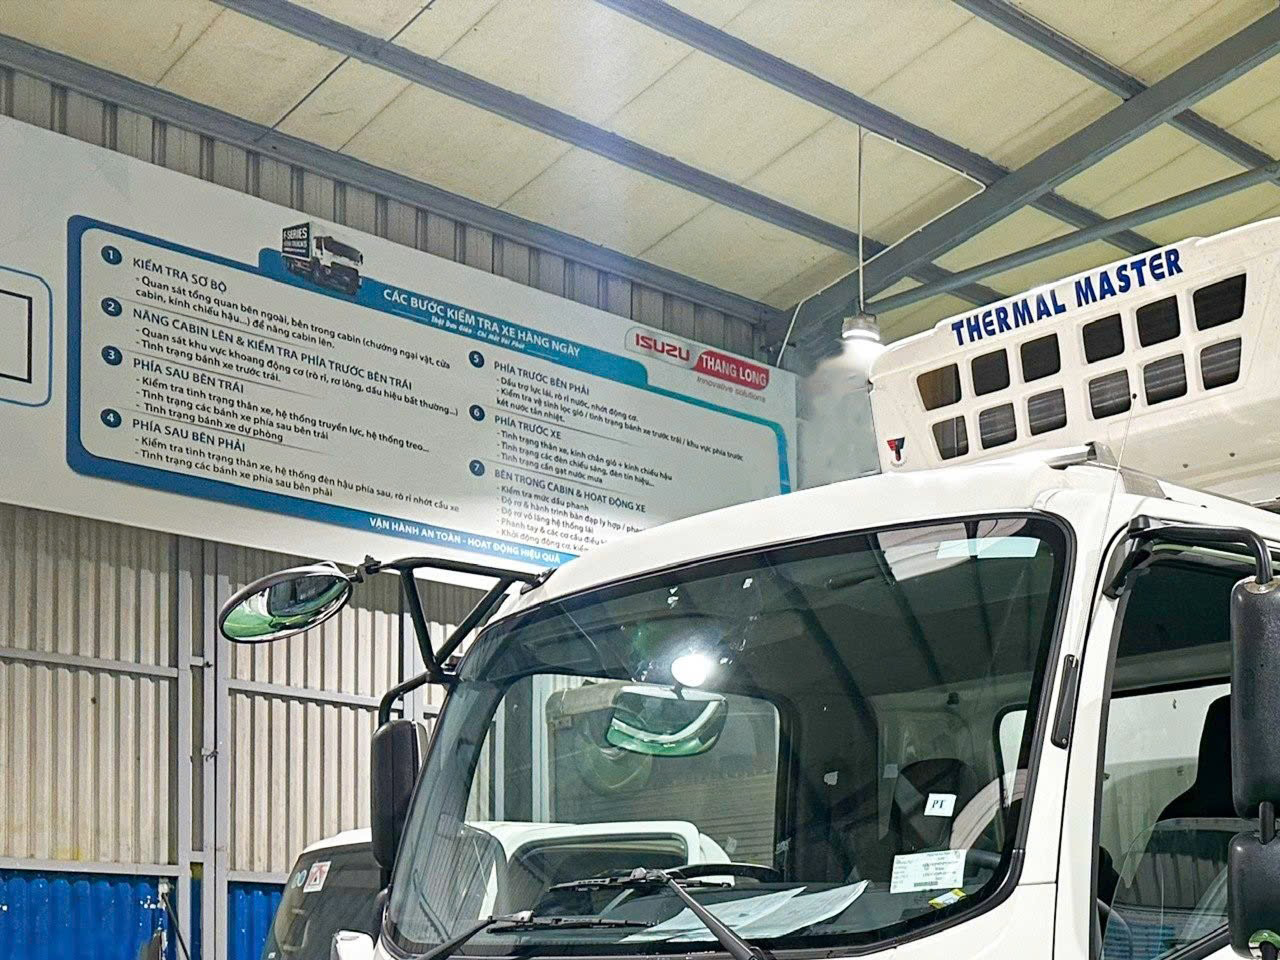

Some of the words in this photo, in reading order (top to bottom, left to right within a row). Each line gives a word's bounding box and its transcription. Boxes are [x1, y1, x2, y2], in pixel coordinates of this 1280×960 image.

[108, 249, 113, 259] 1
[132, 257, 163, 274] KIỂM
[164, 265, 189, 282] TRA
[191, 273, 208, 287] SƠ
[210, 278, 227, 294] BỘ
[951, 289, 1066, 346] THERMAL
[1074, 248, 1183, 308] MASTER
[383, 288, 408, 305] CÁC
[410, 296, 445, 316] BƯỚC
[446, 307, 475, 326] KIỂM
[476, 316, 500, 333] TRA
[501, 324, 516, 338] XE
[517, 329, 549, 348] HÀNG
[551, 340, 580, 356] NGÀY
[107, 300, 115, 312] 2
[133, 307, 169, 327] NÂNG
[171, 318, 209, 337] CABIN
[211, 329, 233, 344] LÊN
[235, 335, 245, 347] &
[246, 338, 275, 354] KIỂM
[276, 345, 298, 360] TRA
[300, 352, 327, 369] PHÍA
[327, 359, 364, 379] TRƯỚC
[366, 370, 387, 384] BÊN
[388, 376, 412, 391] TRÁI
[635, 333, 690, 362] ISUZU
[701, 354, 737, 377] THANG
[739, 368, 767, 386] LONG
[107, 349, 115, 360] 3
[133, 357, 163, 374] PHÍA
[165, 365, 189, 380] SAU
[192, 372, 215, 387] BÊN
[217, 378, 244, 394] TRÁI
[473, 353, 479, 363] 5
[493, 360, 516, 375] PHÍA
[516, 367, 548, 384] TRƯỚC
[549, 377, 567, 390] BÊN
[568, 382, 589, 395] PHẢI
[697, 376, 733, 394] Innovative
[106, 412, 114, 422] 4
[132, 418, 162, 434] PHÍA
[164, 425, 189, 439] SAU
[191, 431, 215, 446] BÊN
[217, 436, 245, 452] PHẢI
[473, 407, 480, 417] 6
[494, 414, 516, 428] PHÍA
[517, 420, 548, 437] TRƯỚC
[550, 428, 561, 440] XE
[473, 462, 480, 471] 7
